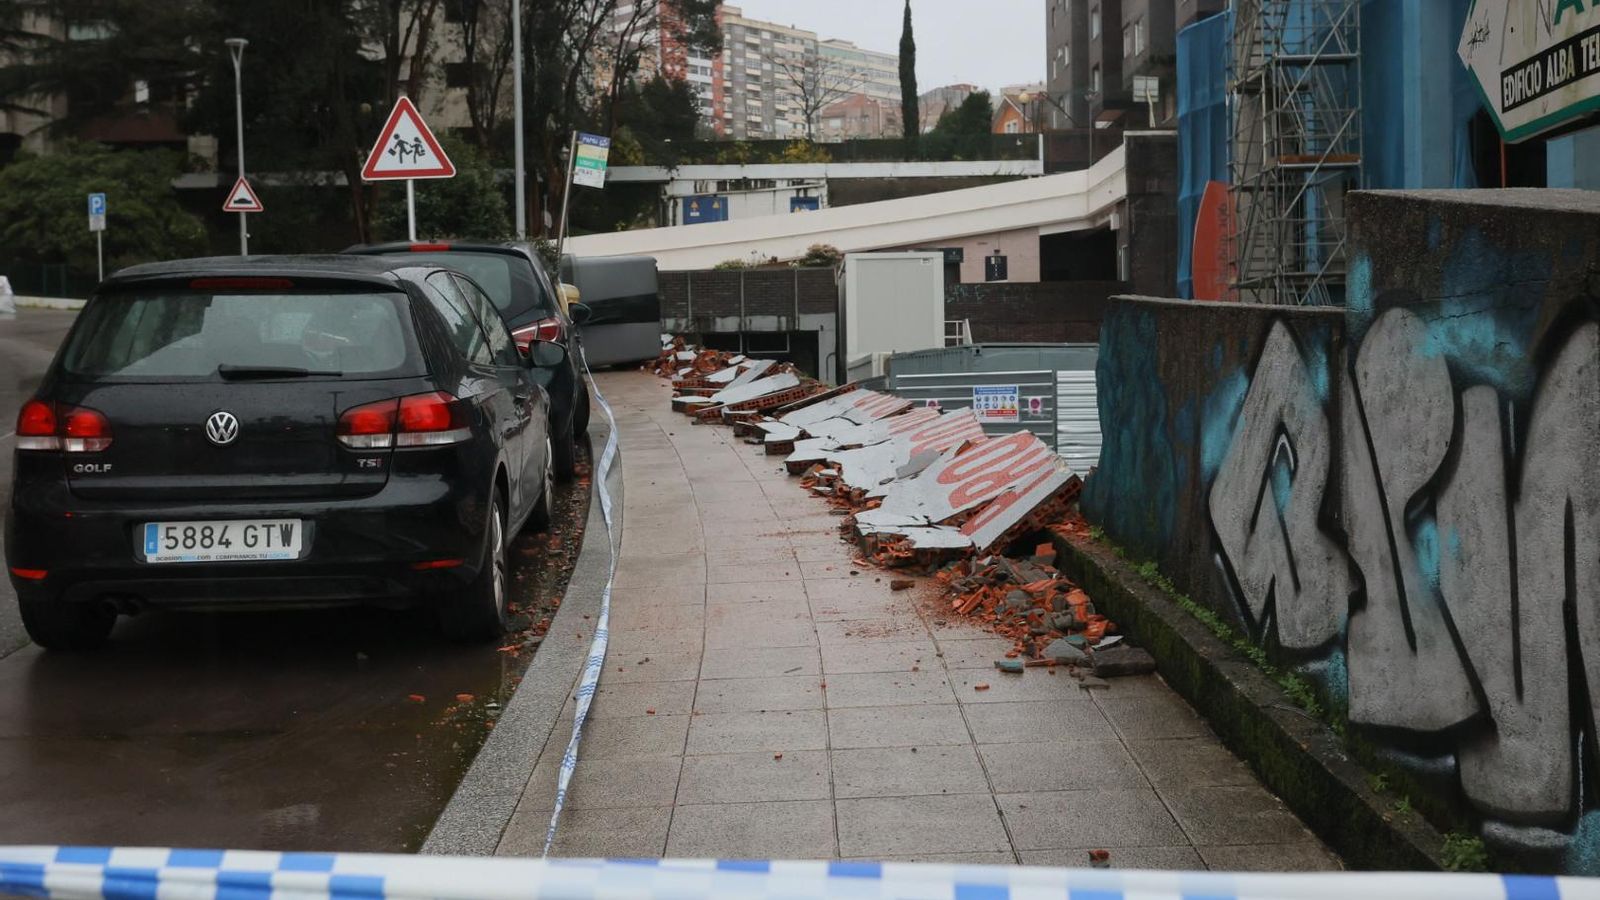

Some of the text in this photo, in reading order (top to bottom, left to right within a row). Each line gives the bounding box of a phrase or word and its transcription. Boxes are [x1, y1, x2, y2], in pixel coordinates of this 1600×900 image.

[1503, 60, 1542, 108] EDIFICIO
[1546, 45, 1575, 89] ALBA
[92, 196, 102, 214] P
[73, 463, 112, 473] GOLF
[165, 523, 294, 550] 5884 GTW
